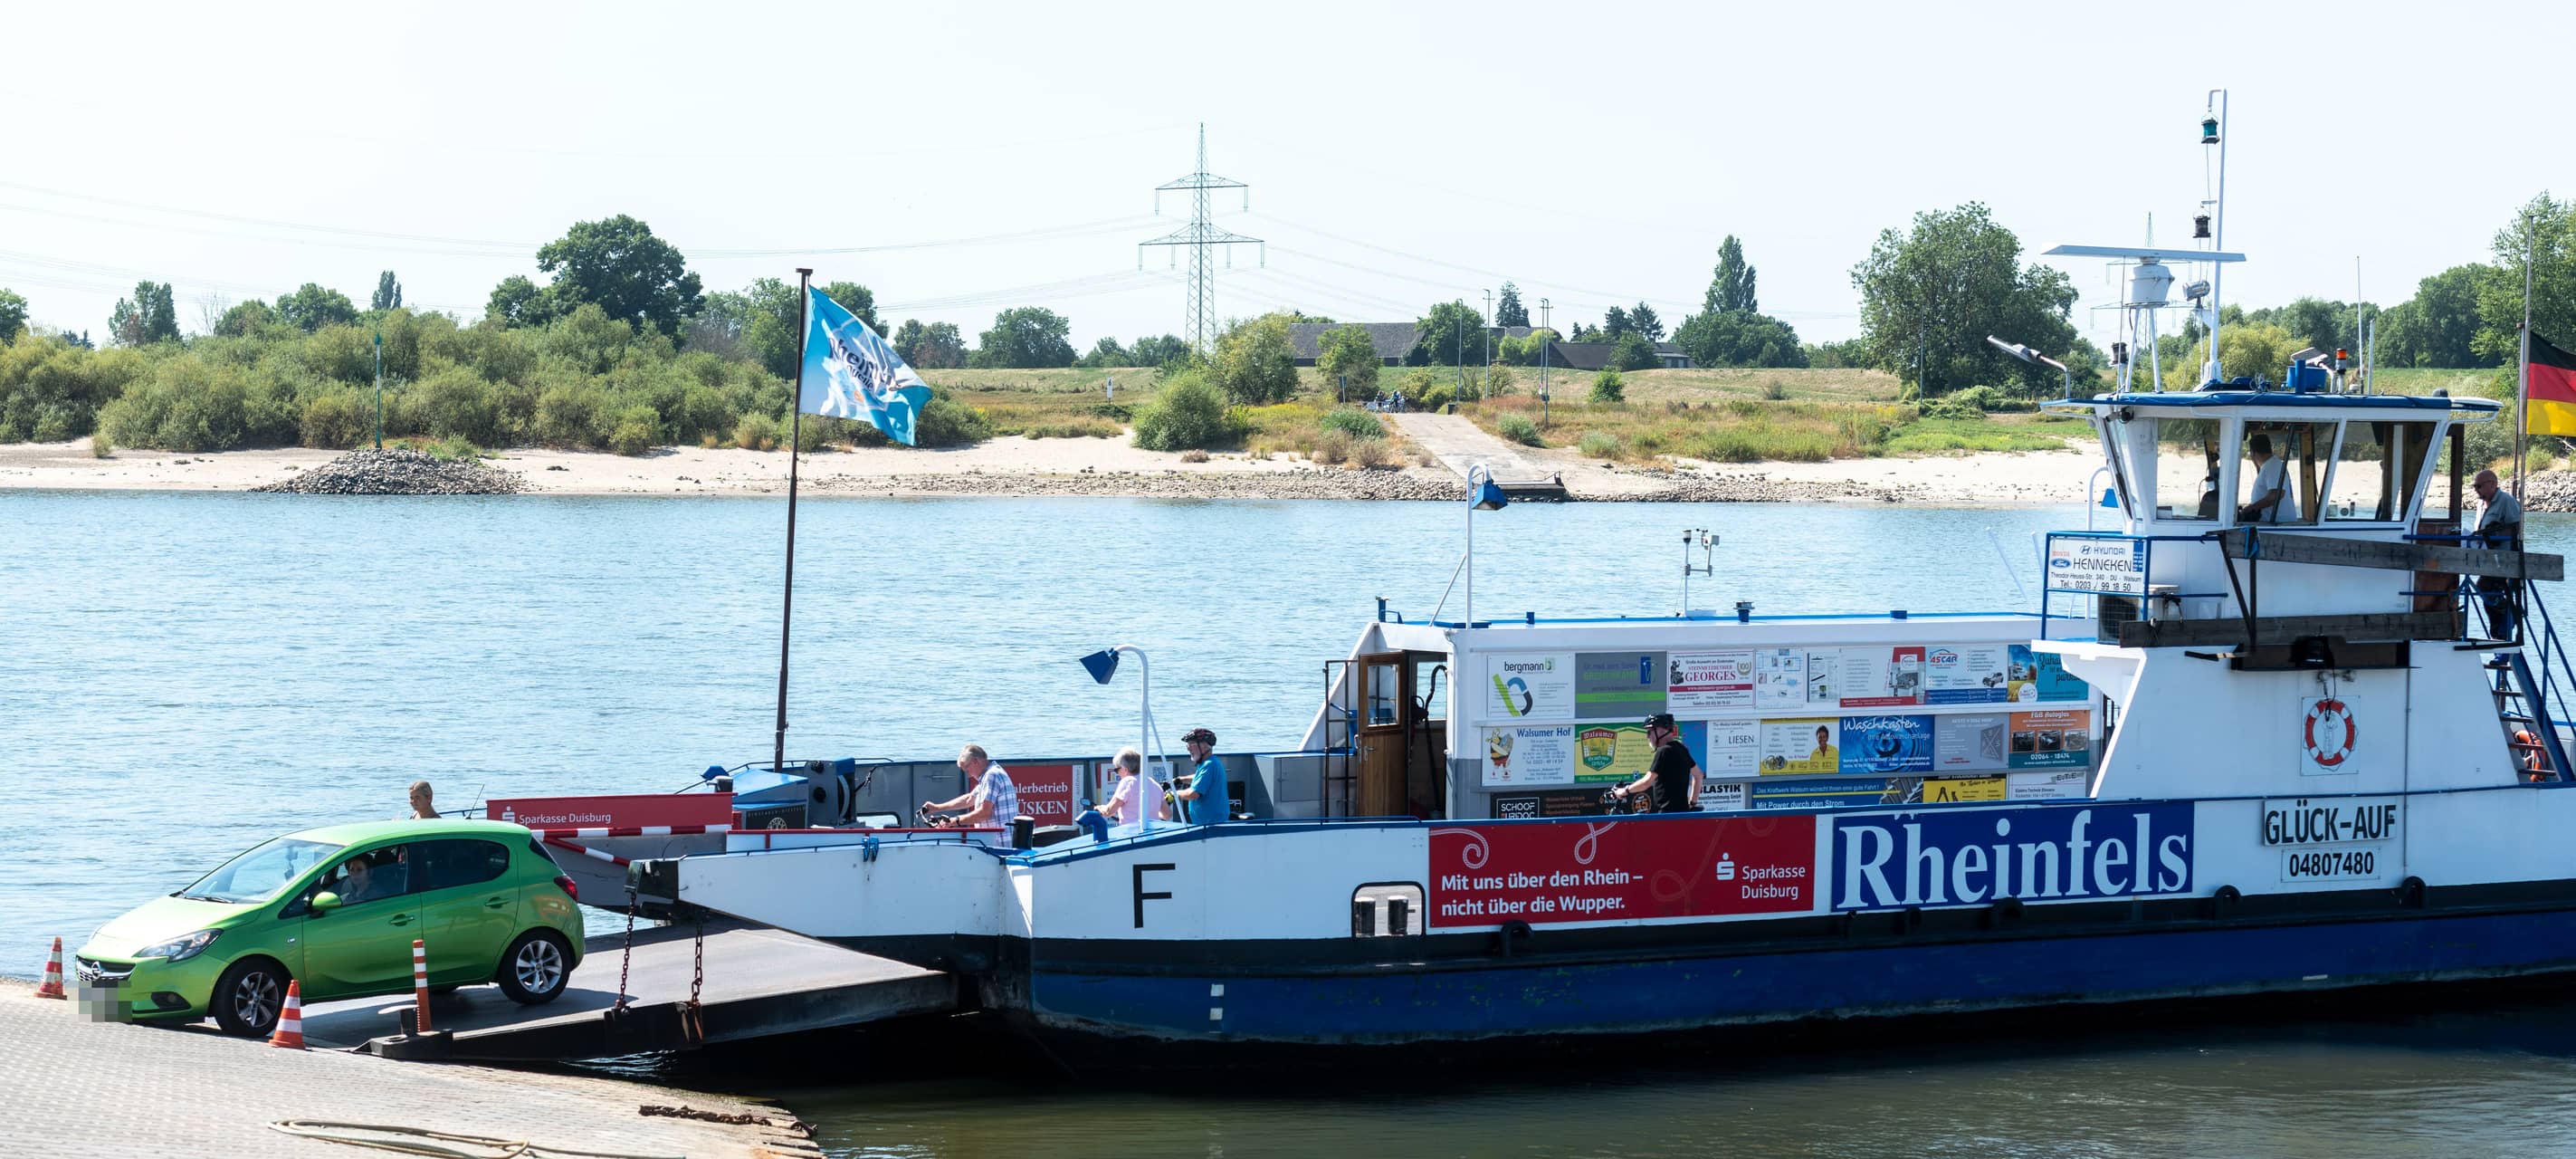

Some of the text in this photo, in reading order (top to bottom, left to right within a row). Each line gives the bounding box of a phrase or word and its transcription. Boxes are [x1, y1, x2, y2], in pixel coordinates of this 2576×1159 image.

[2094, 546, 2126, 556] HYUNDAI
[2073, 557, 2132, 572] HENNEKEN
[2075, 580, 2091, 589] 0203
[2101, 582, 2109, 590] 99
[2123, 583, 2131, 591] 50
[1504, 661, 1544, 674] bergmann
[1684, 670, 1736, 682] GEORGES
[1843, 715, 1921, 733] Waschkasten
[1516, 727, 1571, 738] Walsumer Hof
[1728, 734, 1754, 744] LIESEN
[1701, 784, 1741, 794] LASTIK
[1016, 799, 1068, 815] ÜSKEN
[1501, 802, 1536, 812] SCHOOF
[1757, 800, 1767, 809] Mit
[1768, 800, 1789, 809] Power
[1790, 800, 1809, 808] durch
[519, 814, 567, 826] Sparkasse
[568, 813, 611, 825] Duisburg
[2265, 800, 2397, 845] GLÜCK-AUF
[1836, 809, 2189, 908] Rheinfels
[2289, 851, 2374, 877] 04807480
[1441, 874, 1469, 891] Mit
[1473, 876, 1503, 890] uns
[1508, 872, 1546, 889] über
[1550, 870, 1579, 887] den
[1584, 868, 1629, 886] Rhein
[1741, 864, 1806, 883] Sparkasse
[1133, 863, 1176, 928] F
[1741, 884, 1798, 900] Duisburg
[1441, 895, 1626, 916] nicht über die Wupper.
